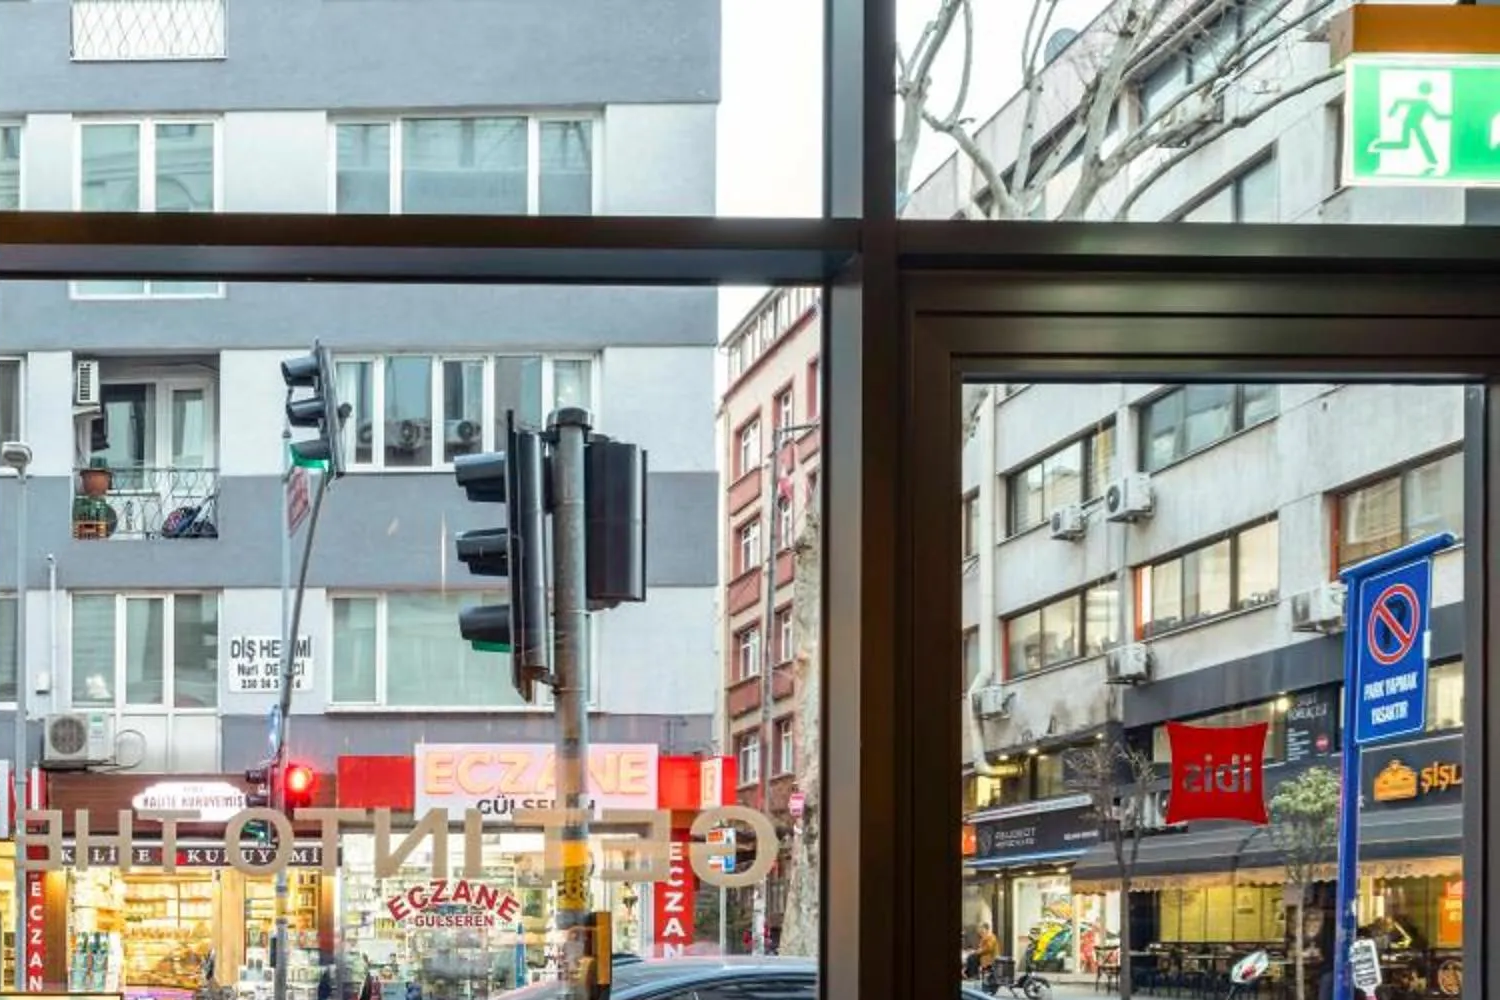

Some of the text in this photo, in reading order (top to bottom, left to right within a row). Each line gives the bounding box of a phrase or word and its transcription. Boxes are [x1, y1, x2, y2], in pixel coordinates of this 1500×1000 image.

[231, 636, 311, 662] DİŞ HEMİ
[1364, 671, 1418, 701] PARK YAPMAK
[61, 845, 151, 863] KLİE
[386, 878, 522, 923] ECZANE
